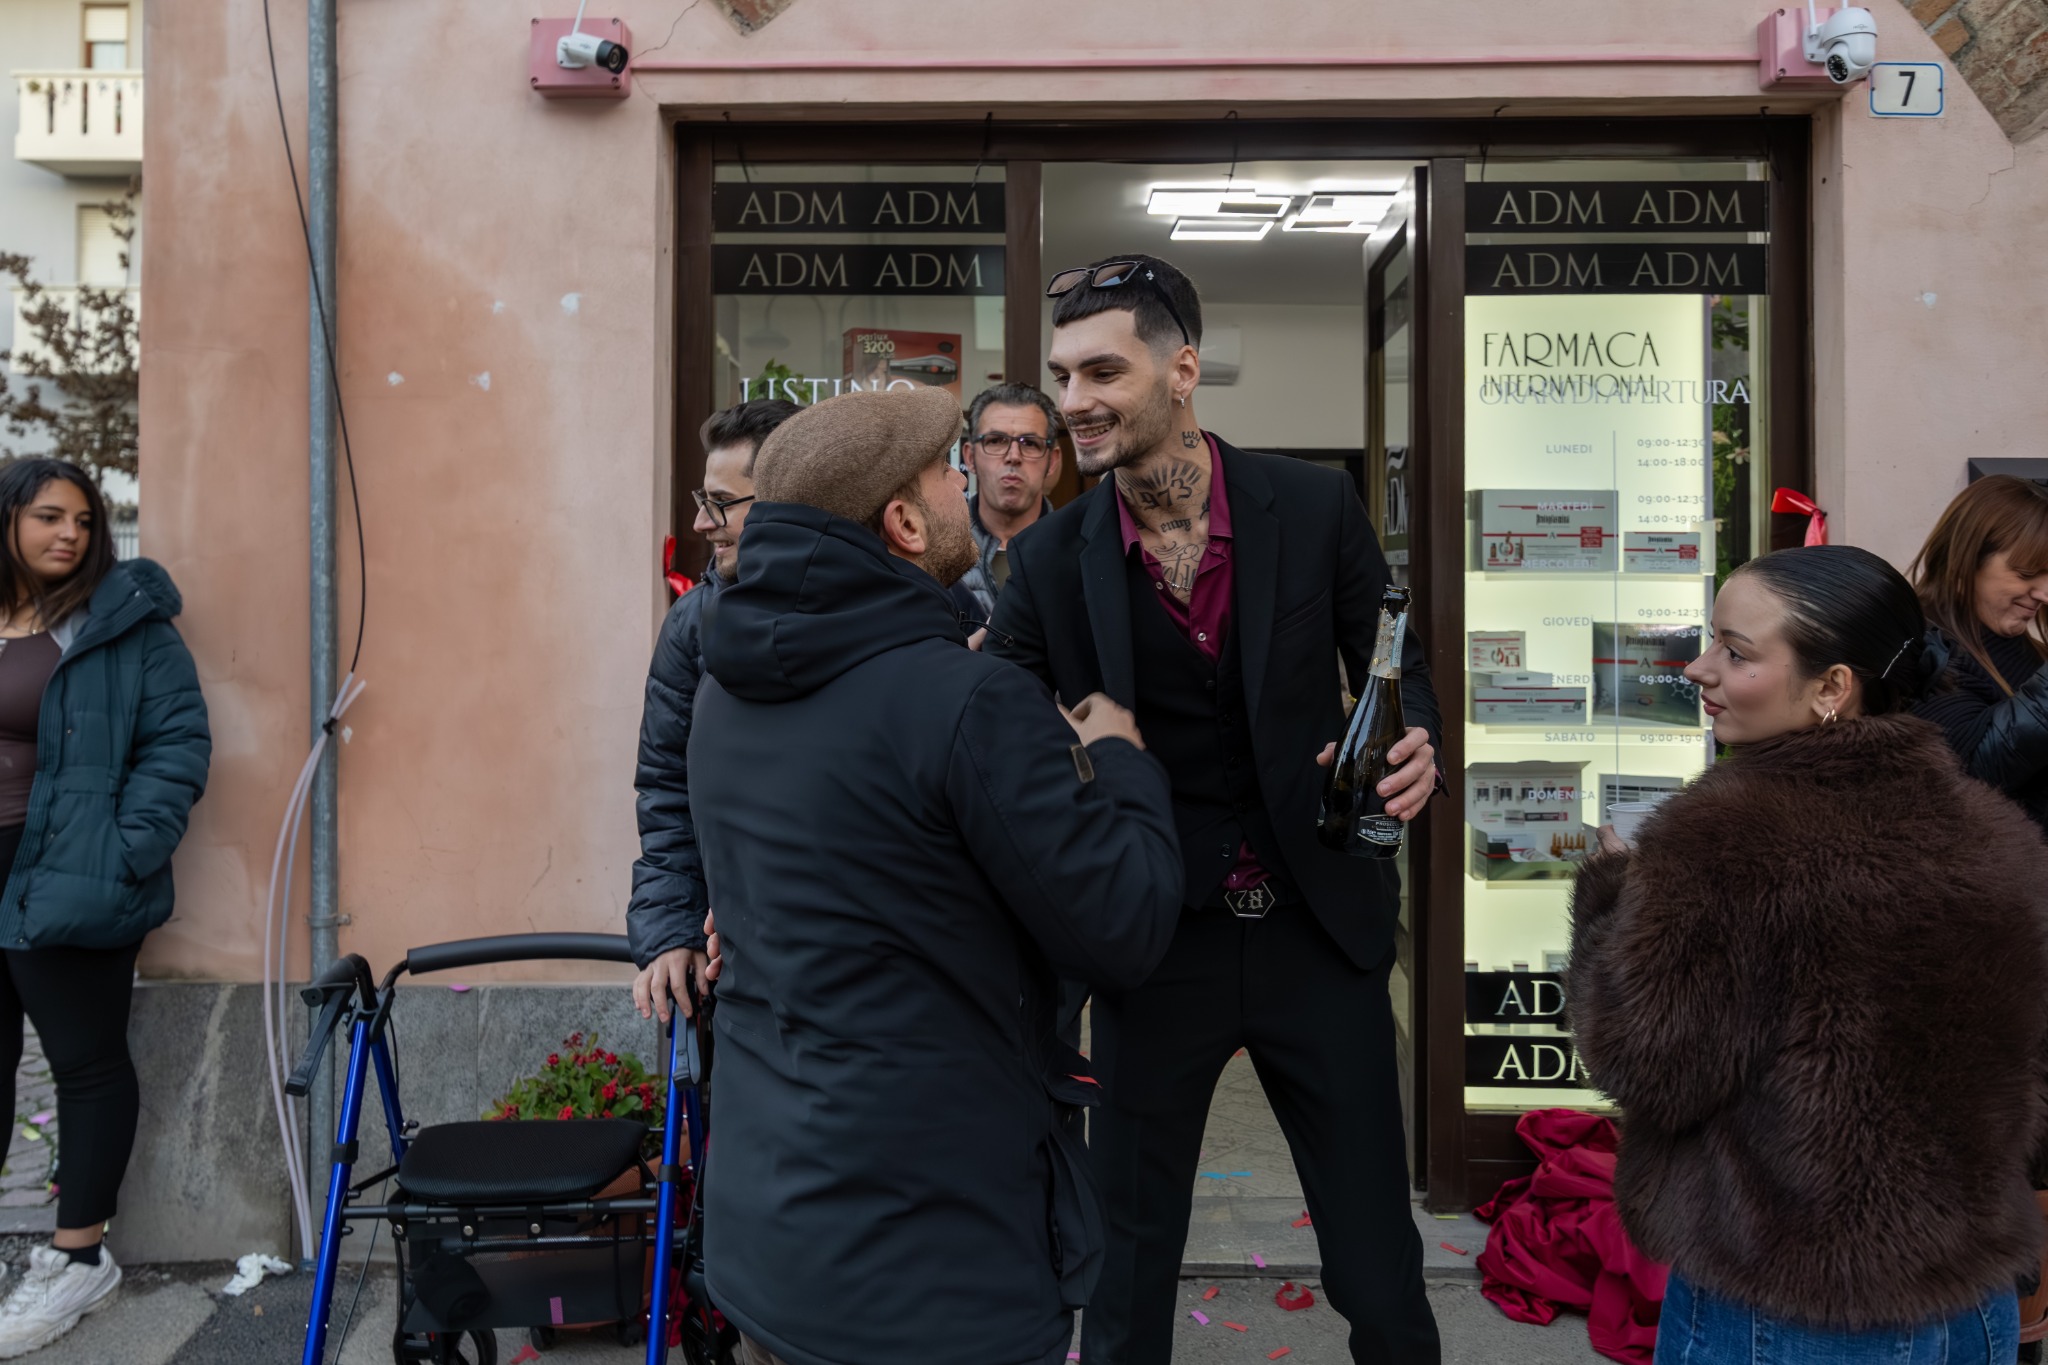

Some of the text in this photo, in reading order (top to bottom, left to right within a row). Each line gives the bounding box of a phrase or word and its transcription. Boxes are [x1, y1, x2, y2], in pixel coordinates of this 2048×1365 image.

[1898, 71, 1916, 107] 7
[737, 190, 983, 225] ADM ADM
[1492, 189, 1744, 225] ADM ADM
[738, 252, 984, 287] ADM ADM
[1491, 252, 1744, 288] ADM ADM
[863, 340, 895, 354] 3200
[1483, 331, 1660, 368] FARMACA
[1479, 380, 1564, 405] ORARI
[1604, 379, 1751, 404] APERTURA
[1483, 374, 1658, 397] INTERNATIONAL
[1544, 732, 1595, 742] SABATO
[1528, 790, 1595, 801] DOMENICA
[1494, 980, 1566, 1016] AD
